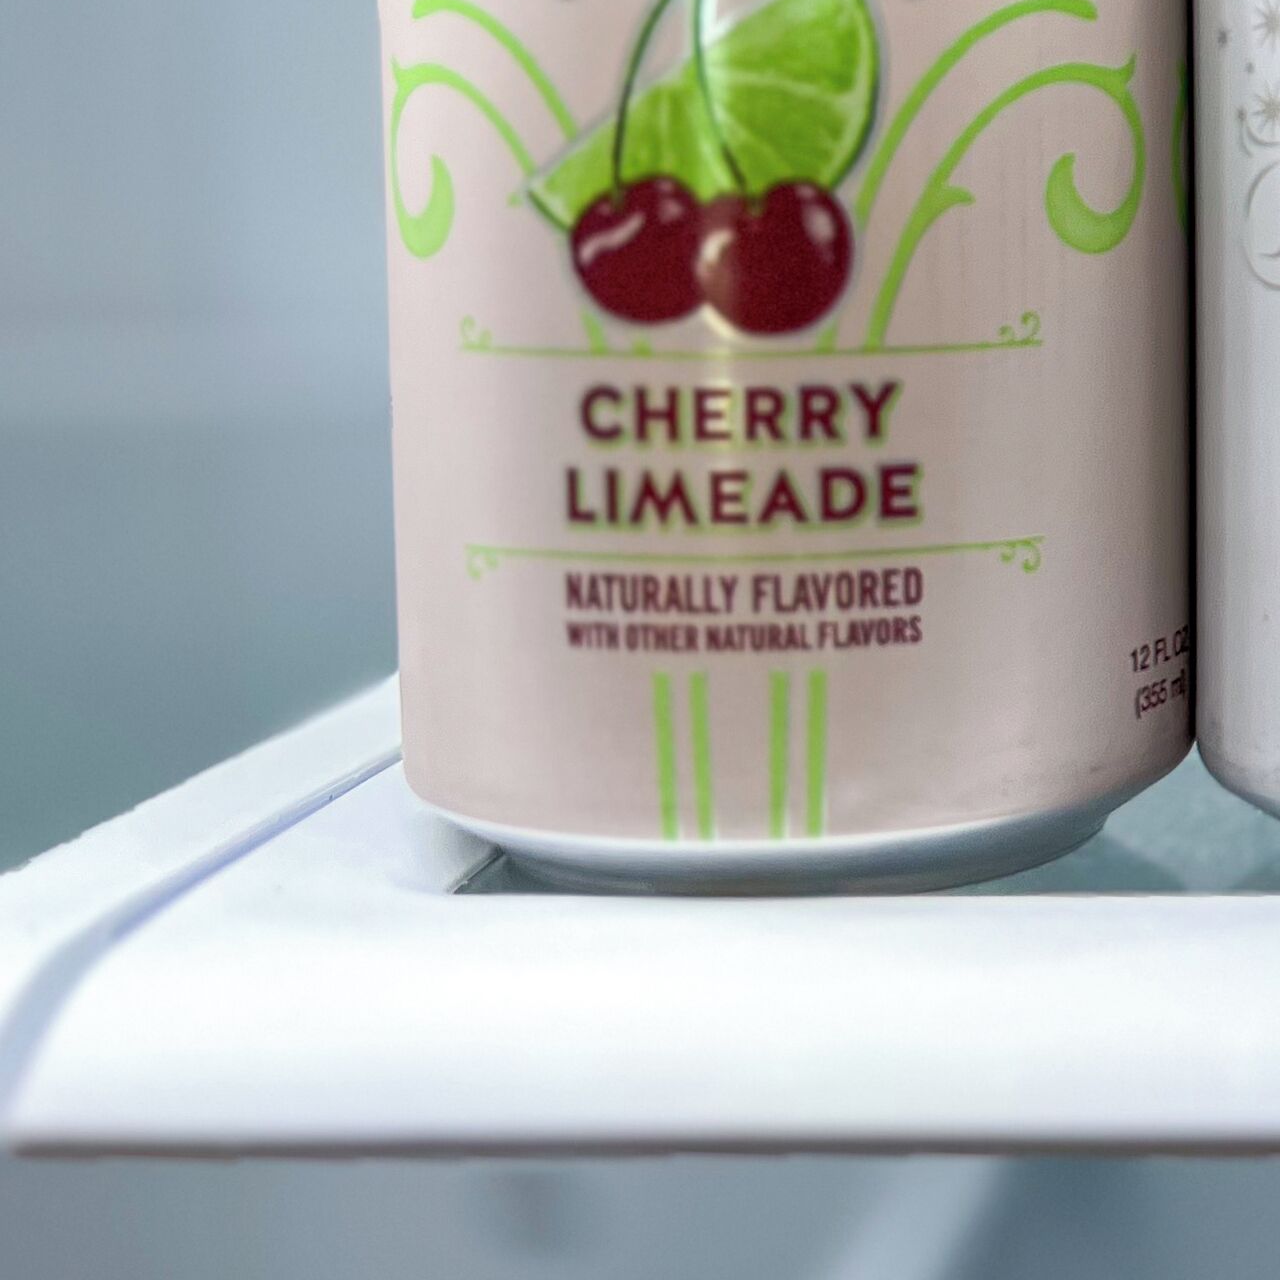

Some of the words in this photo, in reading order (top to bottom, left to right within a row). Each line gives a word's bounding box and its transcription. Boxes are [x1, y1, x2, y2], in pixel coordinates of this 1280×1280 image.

[580, 380, 901, 448] CHERRY
[564, 461, 923, 529] LIMEADE
[565, 572, 739, 615] NATURALLY
[751, 567, 924, 614] FLAVORED
[566, 621, 620, 651] WITH
[625, 622, 699, 653] OTHER
[704, 622, 812, 653] NATURAL
[817, 615, 924, 651] FLAVORS
[1131, 643, 1150, 673] 12
[1135, 678, 1167, 720] (355
